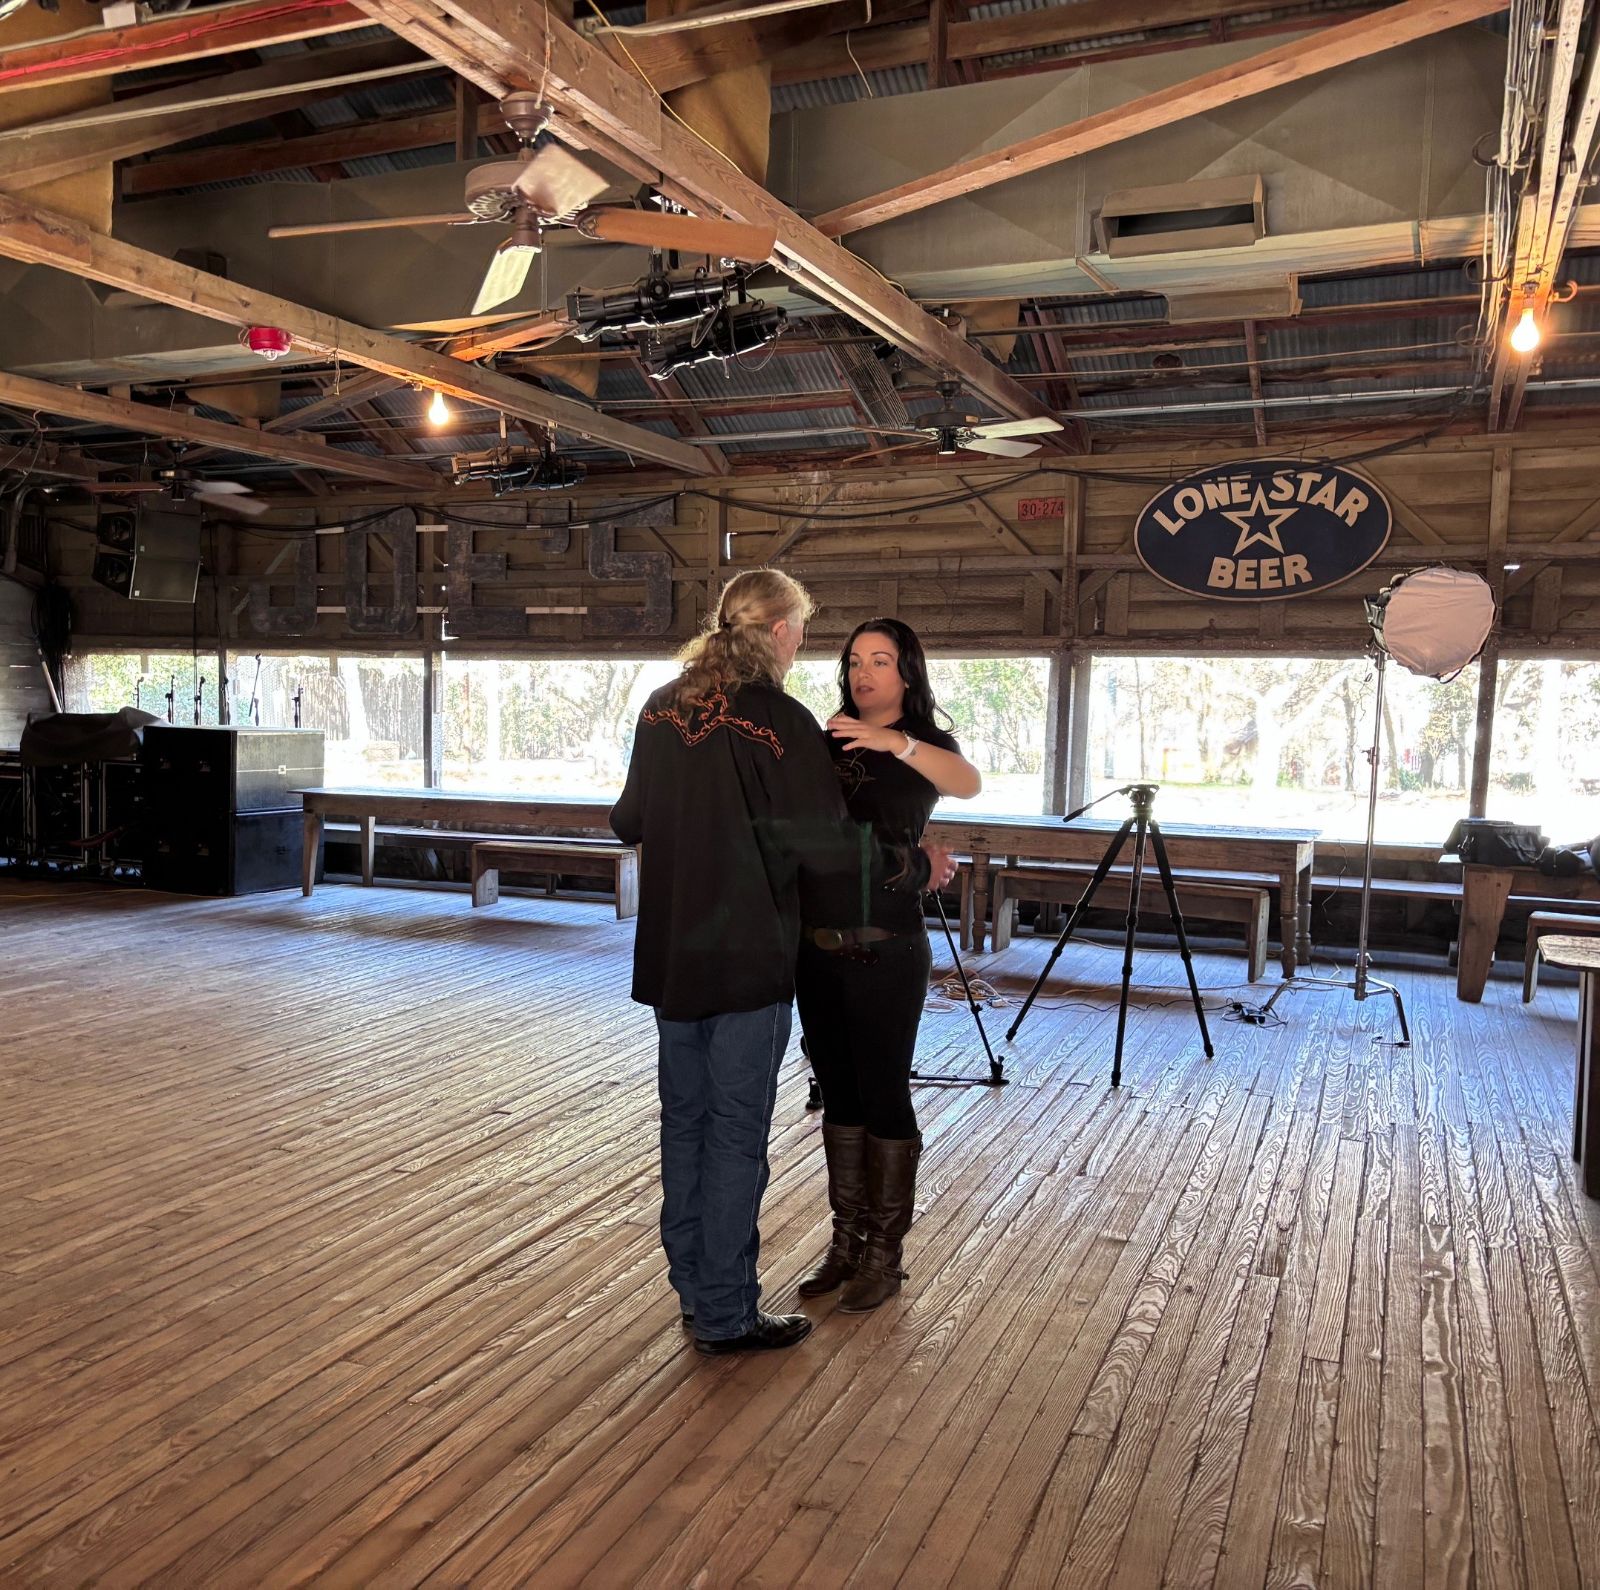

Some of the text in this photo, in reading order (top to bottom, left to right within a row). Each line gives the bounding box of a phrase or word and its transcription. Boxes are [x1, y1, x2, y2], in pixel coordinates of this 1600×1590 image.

[1153, 469, 1369, 536] LONE STAR
[1206, 554, 1313, 590] BEER
